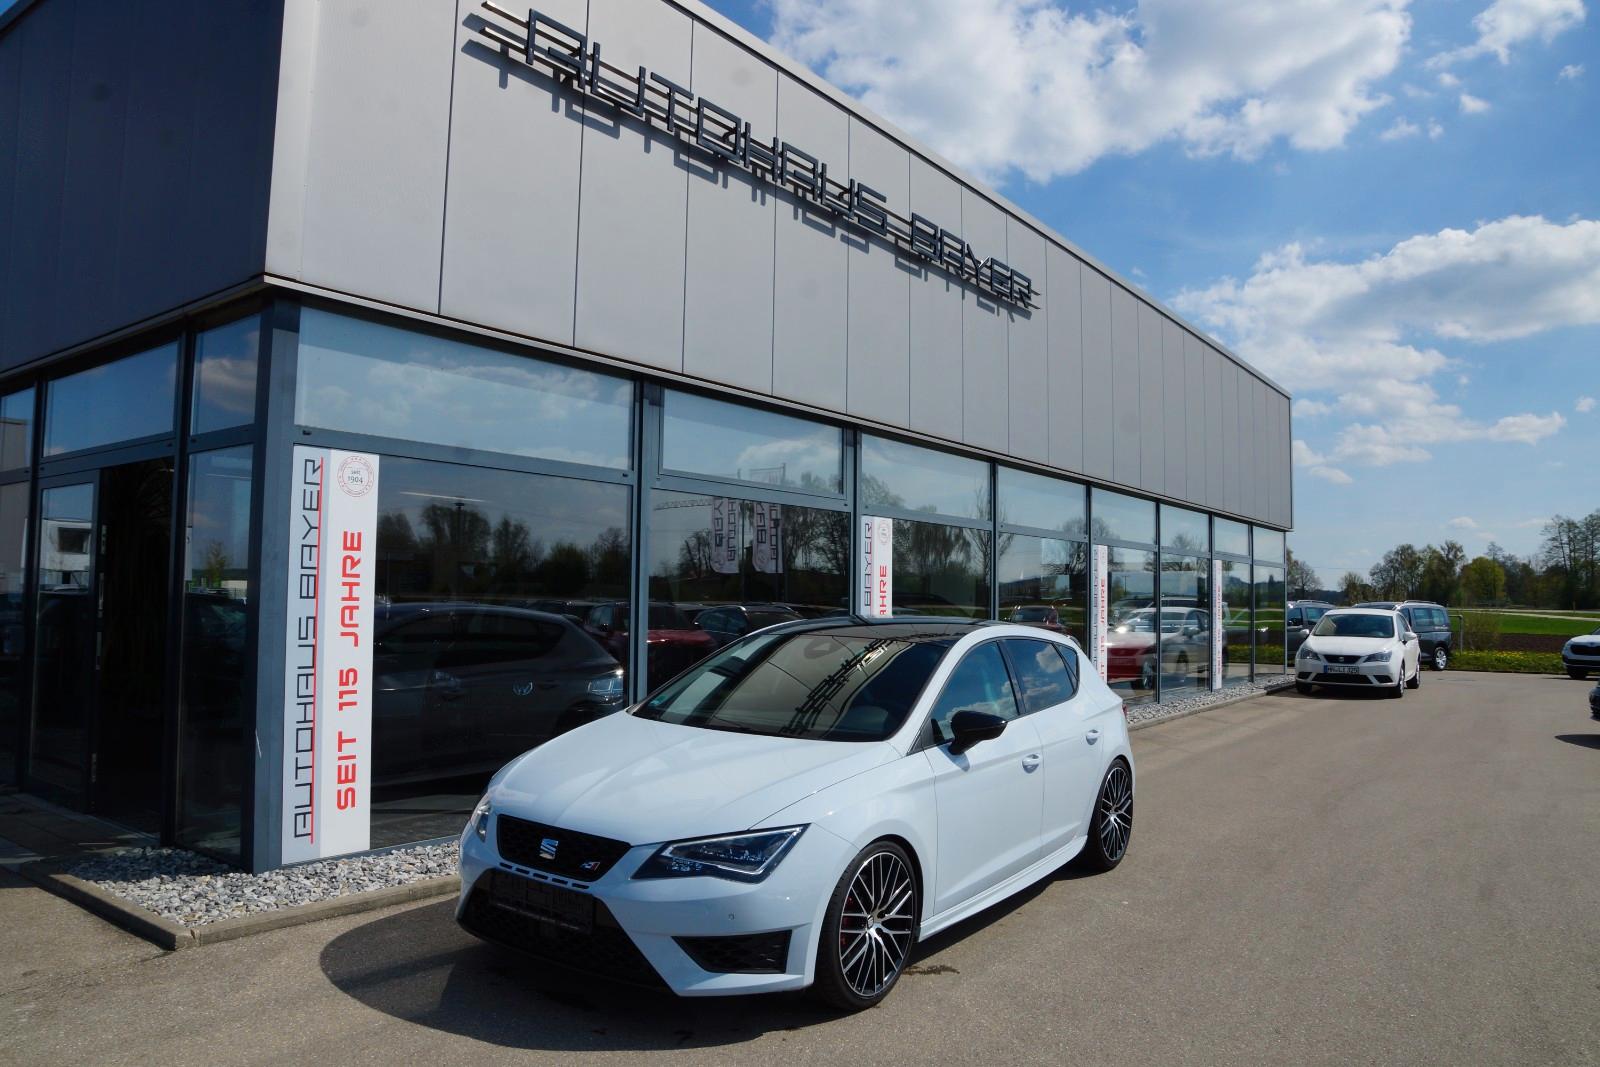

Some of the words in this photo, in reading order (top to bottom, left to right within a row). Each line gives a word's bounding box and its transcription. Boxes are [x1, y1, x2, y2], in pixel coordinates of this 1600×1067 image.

[526, 8, 887, 237] AUTOHAUS
[911, 211, 1032, 306] BAYER
[300, 458, 321, 600] BAYER
[864, 522, 872, 607] BAYER
[339, 530, 362, 647] JAHRE
[879, 565, 887, 615] HRE
[294, 616, 316, 838] AUTOHAUS
[338, 667, 358, 711] 115
[337, 731, 357, 811] SEIT
